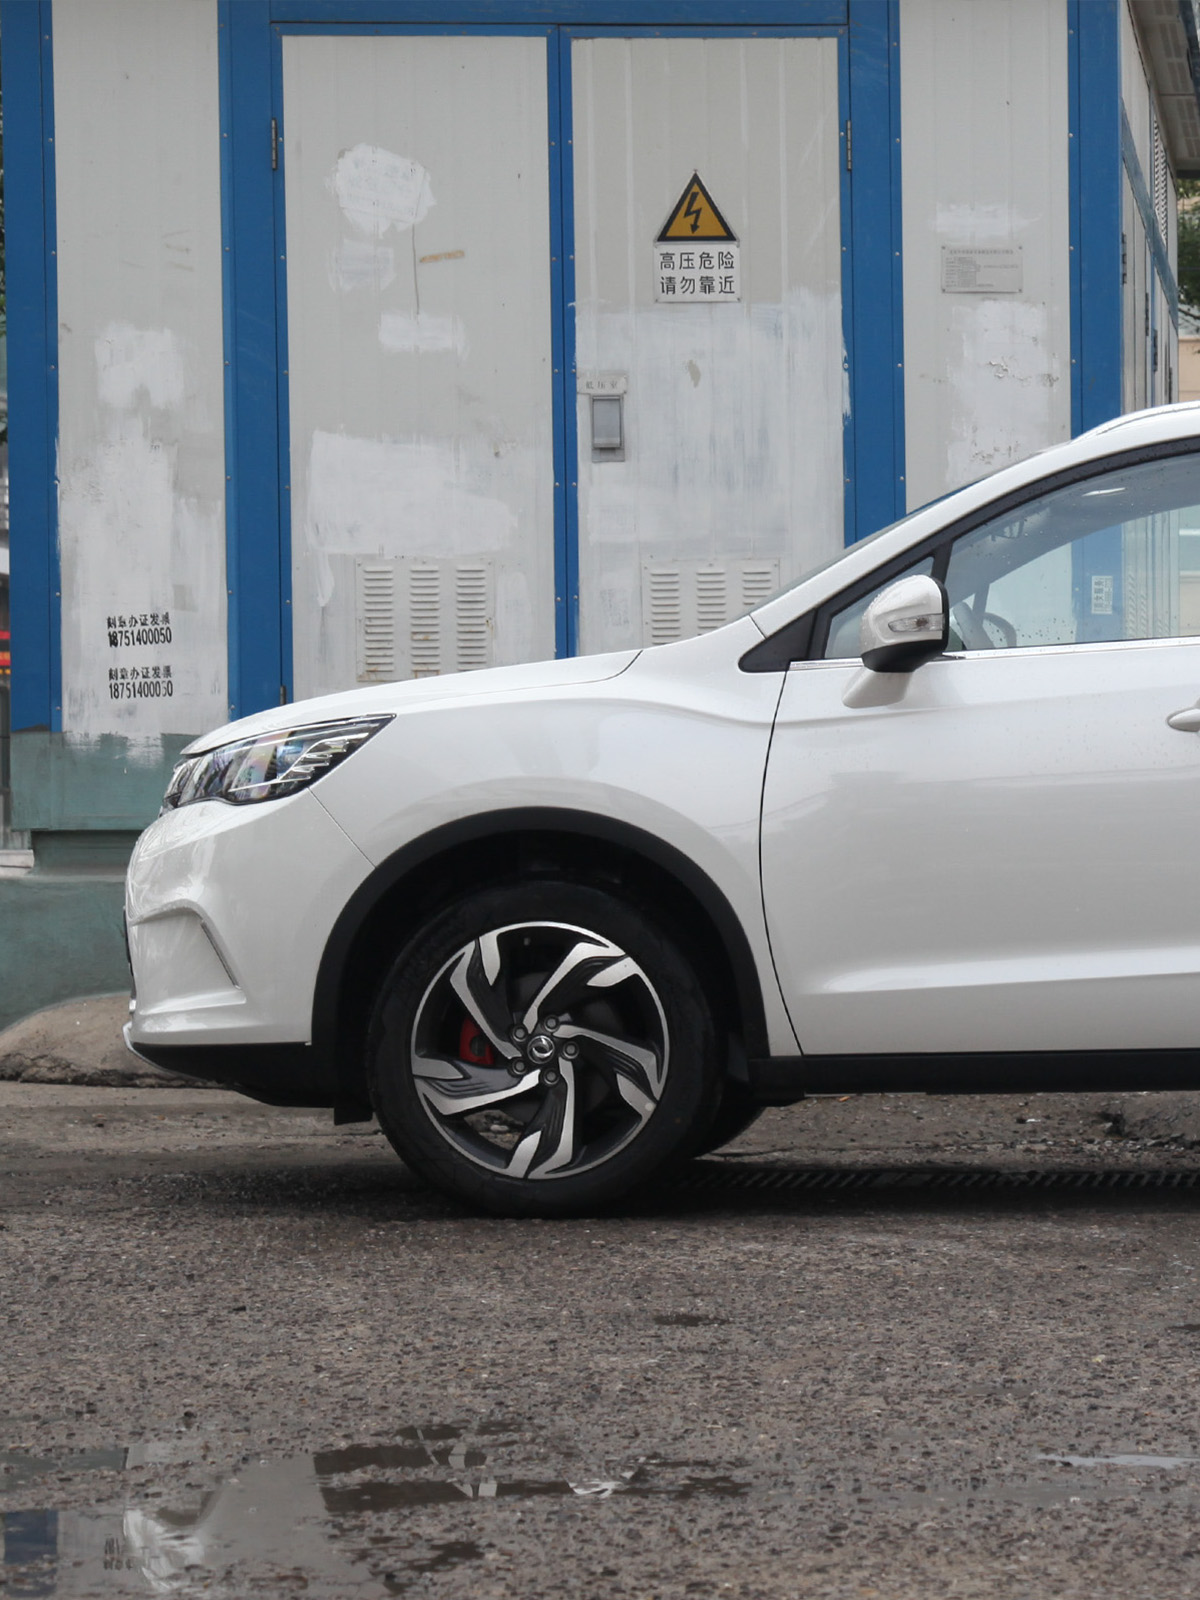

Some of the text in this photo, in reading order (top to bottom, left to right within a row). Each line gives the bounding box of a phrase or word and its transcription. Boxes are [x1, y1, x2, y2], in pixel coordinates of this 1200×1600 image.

[659, 251, 735, 271] 高压危险
[660, 275, 736, 295] 请勿靠近
[108, 626, 172, 648] 18751400050
